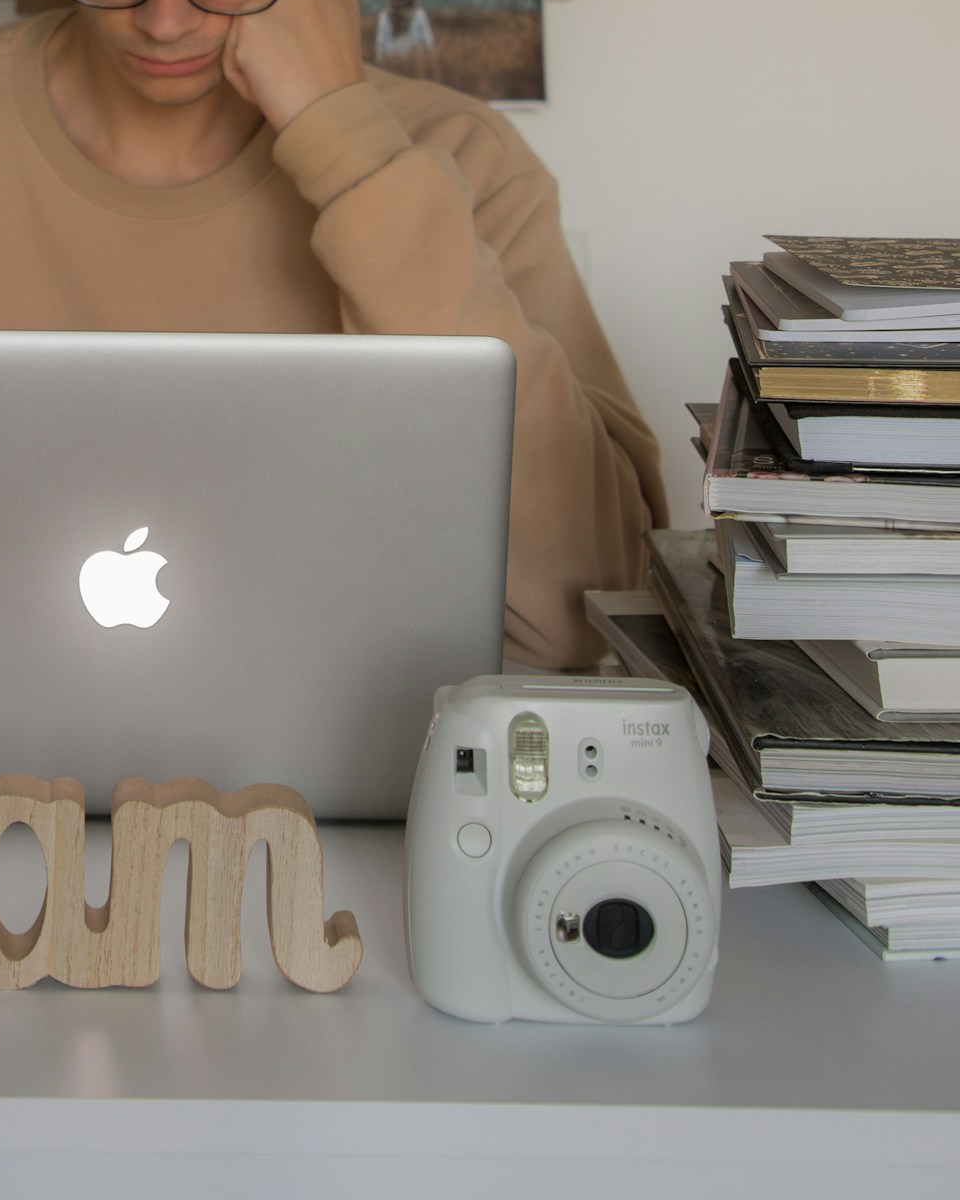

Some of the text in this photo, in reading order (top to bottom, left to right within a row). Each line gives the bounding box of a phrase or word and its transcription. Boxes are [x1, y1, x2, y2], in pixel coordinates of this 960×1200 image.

[622, 718, 670, 736] instax
[631, 738, 663, 748] mini 9
[614, 844, 670, 869] FOCUS
